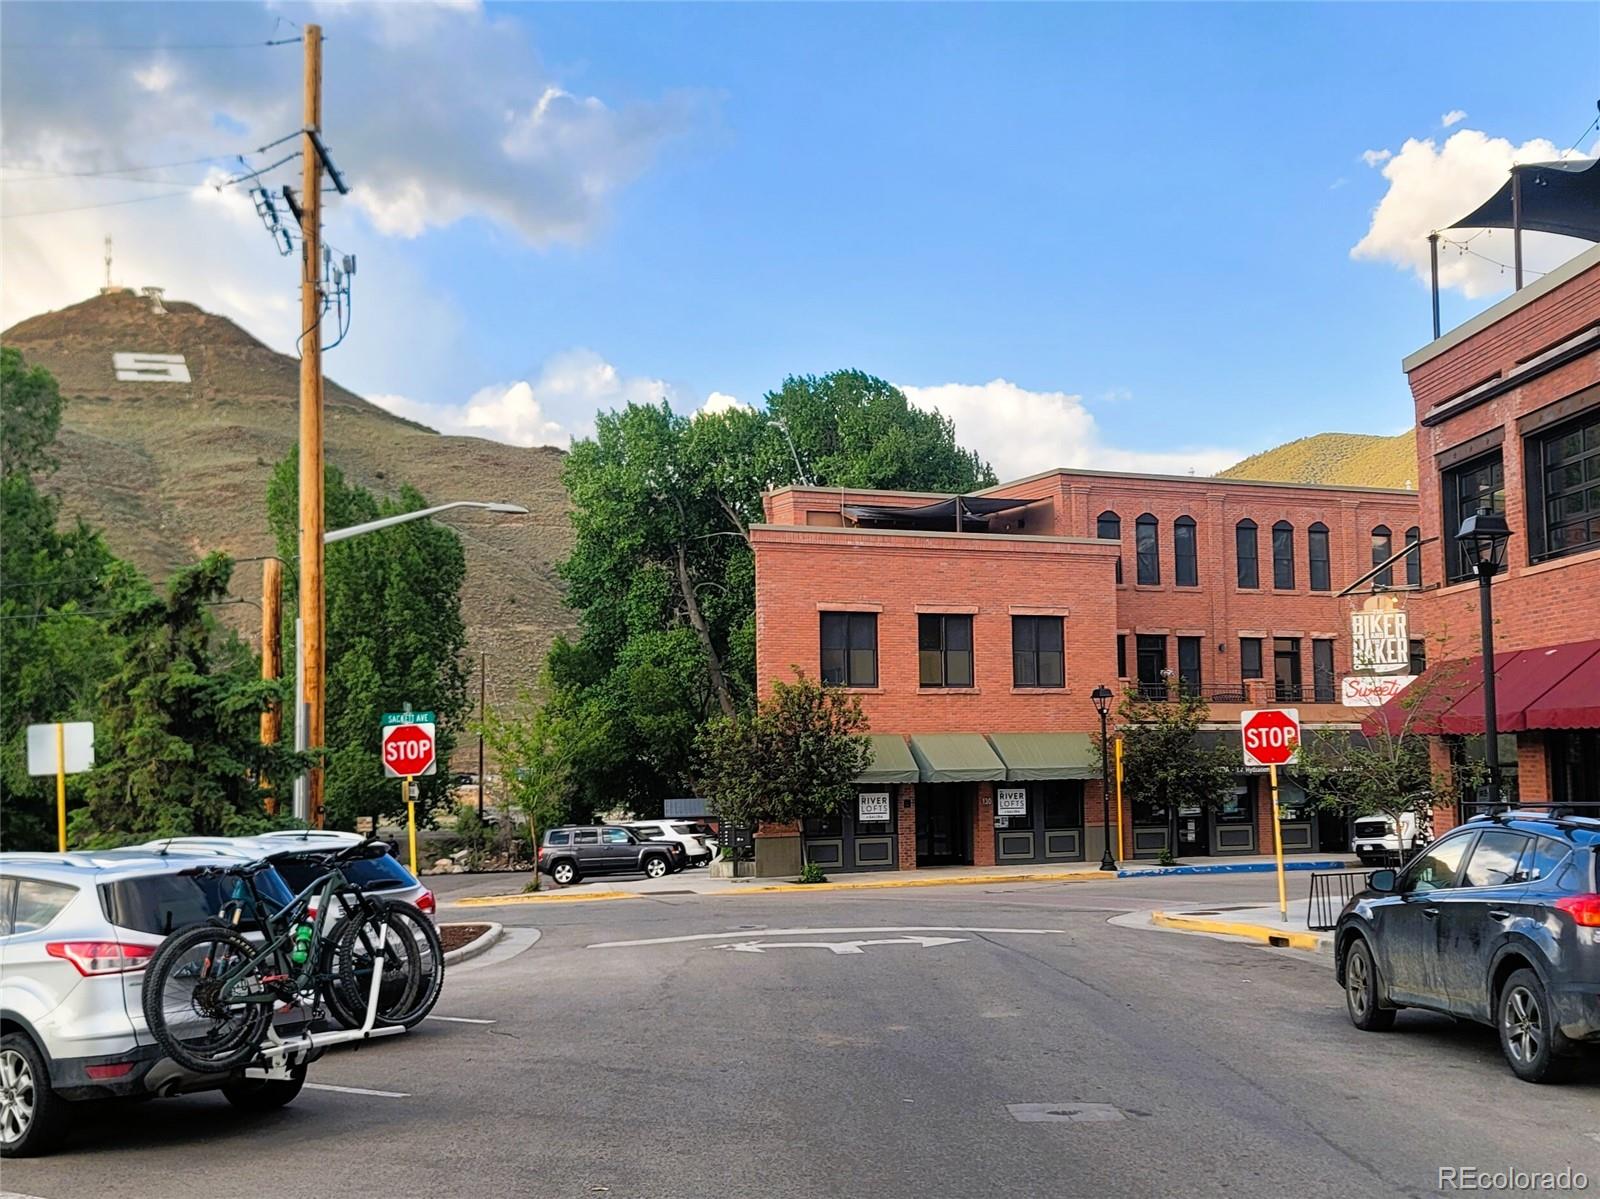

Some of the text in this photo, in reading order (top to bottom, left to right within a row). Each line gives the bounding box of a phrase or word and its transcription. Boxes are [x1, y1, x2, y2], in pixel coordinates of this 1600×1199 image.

[1352, 613, 1407, 638] BIKER
[416, 713, 429, 722] AVE
[1247, 726, 1296, 749] STOP
[386, 740, 430, 762] STOP
[861, 796, 888, 805] RIVER
[1000, 792, 1025, 800] RIVER
[861, 804, 888, 812] LOFTS
[1000, 800, 1025, 808] LOFTS
